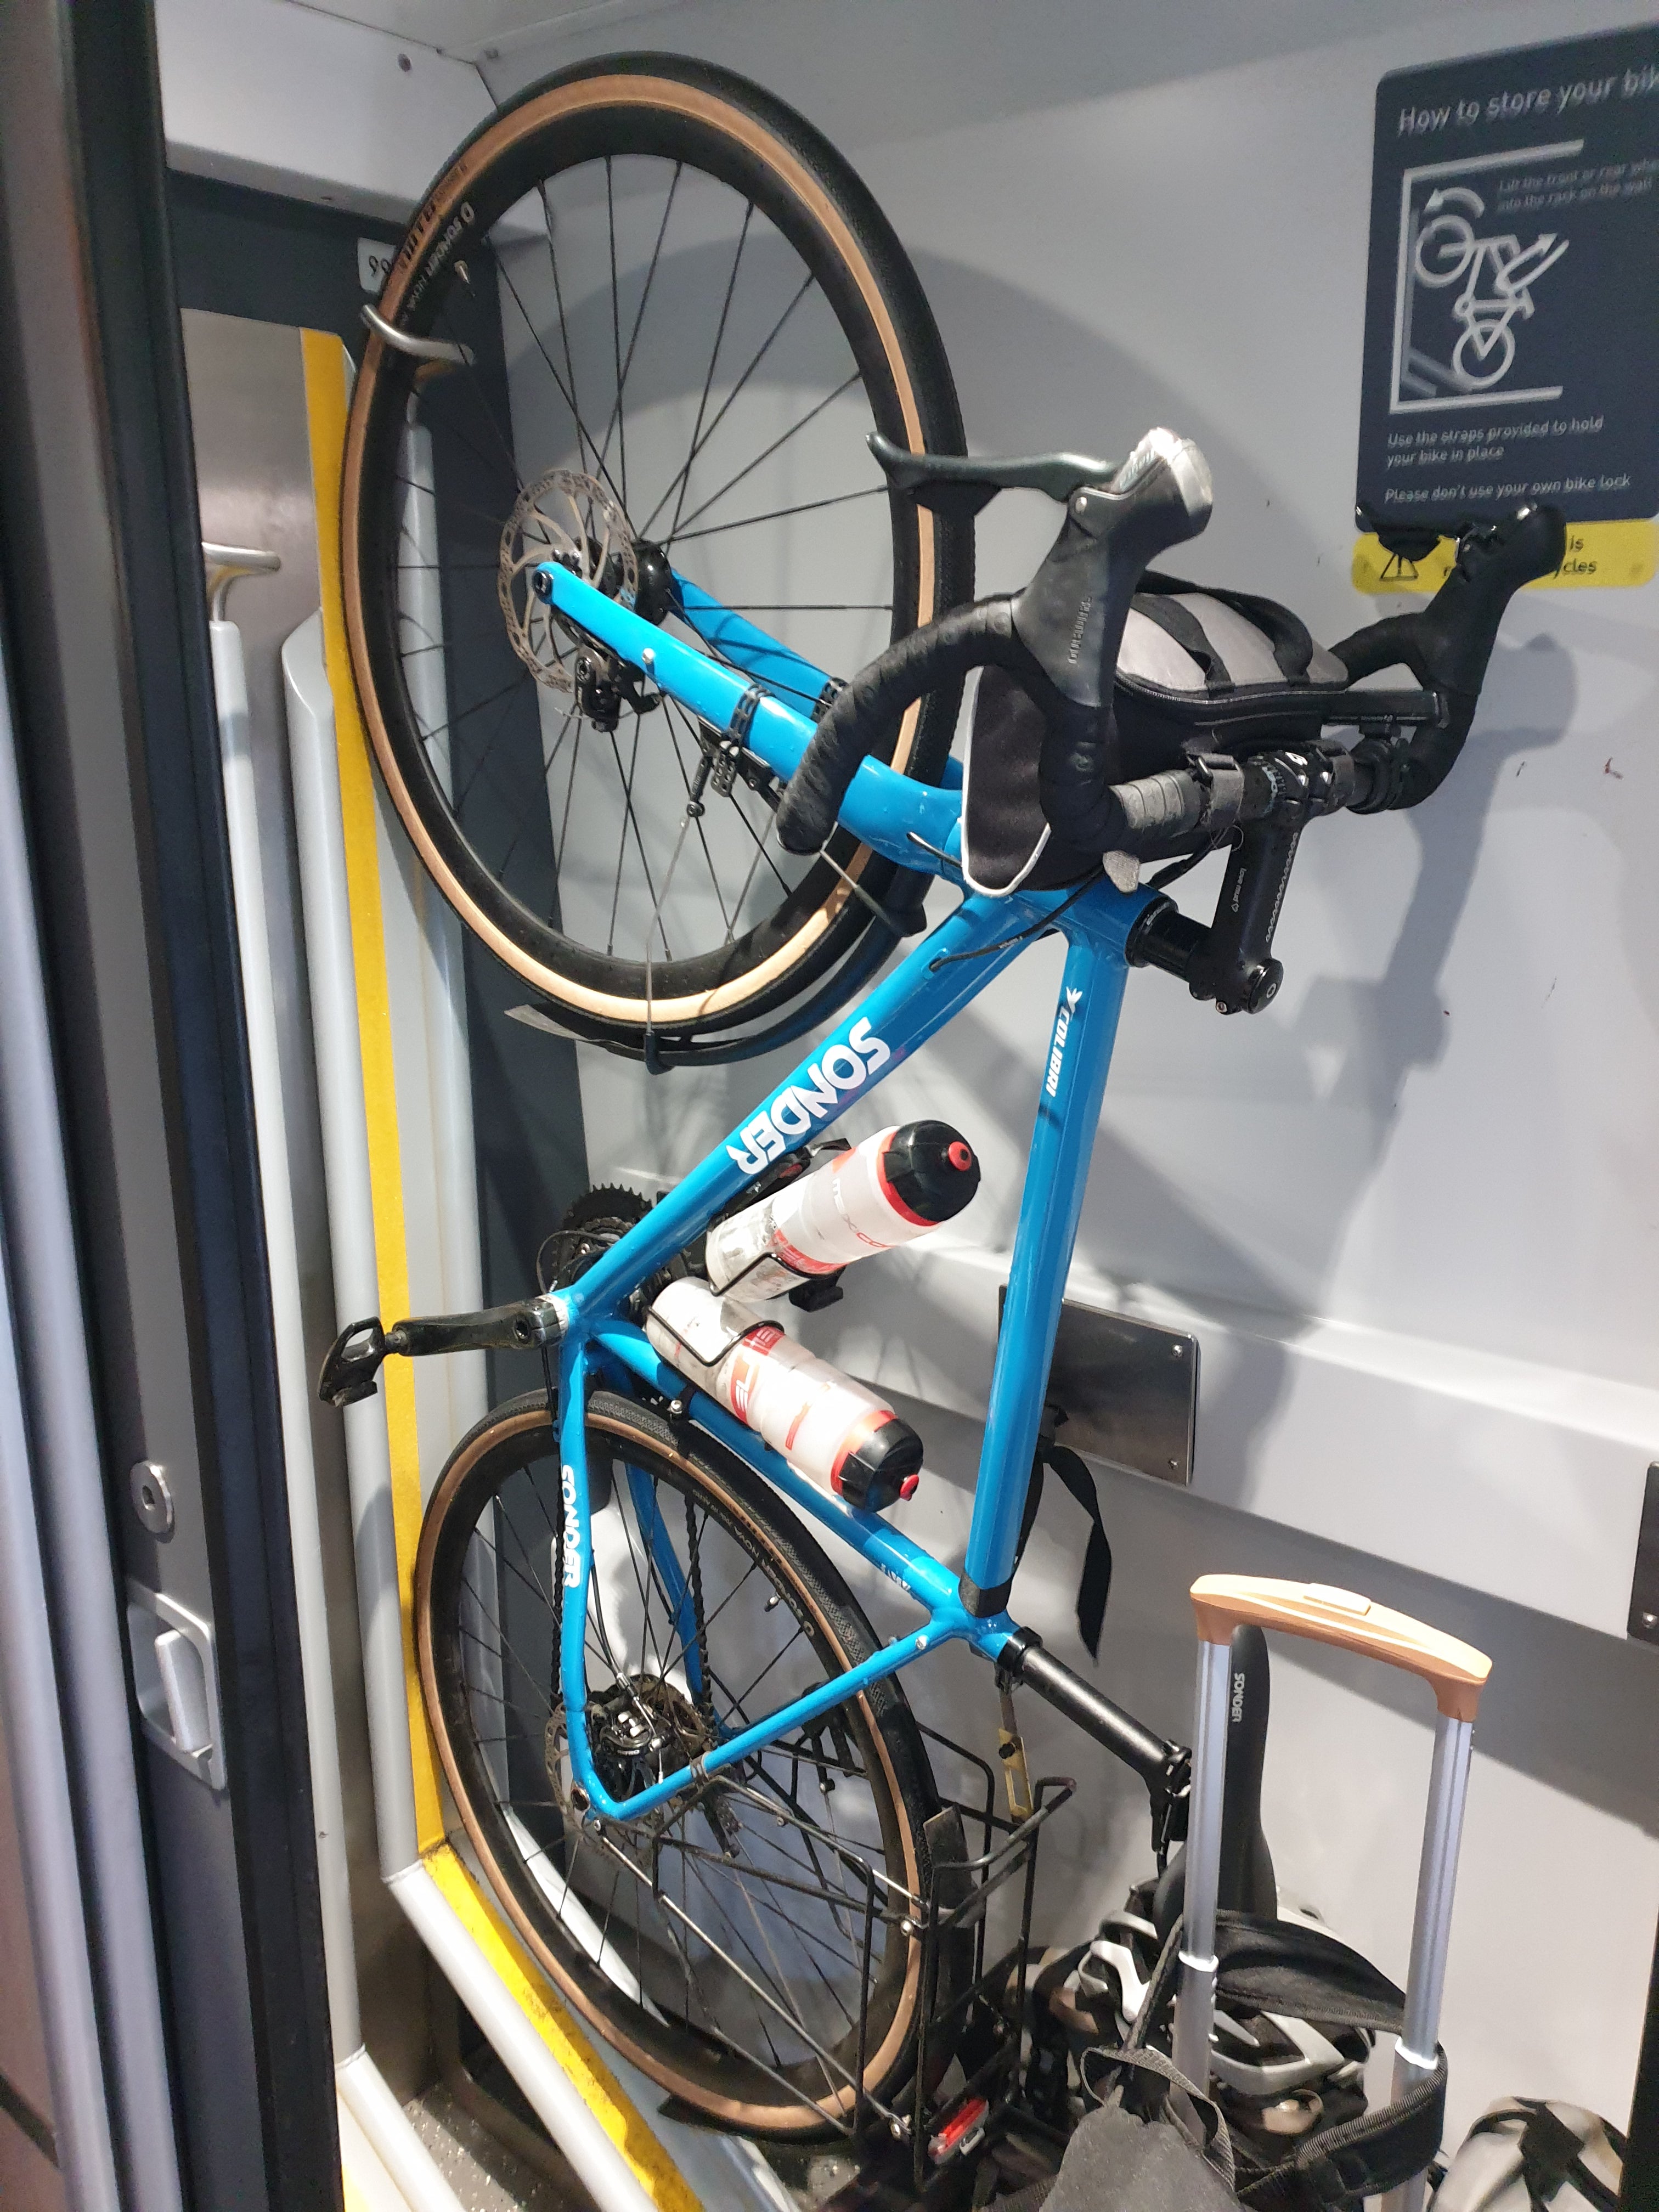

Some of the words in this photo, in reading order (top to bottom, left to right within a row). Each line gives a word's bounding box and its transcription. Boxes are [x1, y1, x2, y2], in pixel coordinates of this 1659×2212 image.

[1397, 105, 1451, 137] How
[1456, 99, 1480, 126] to
[1486, 88, 1551, 122] store
[1557, 77, 1618, 115] your
[1621, 64, 1659, 99] bik
[1386, 453, 1417, 471] your
[1418, 449, 1448, 466] bike
[1451, 448, 1464, 462] in
[1466, 445, 1505, 463] place
[1387, 432, 1414, 448] Use
[1415, 430, 1438, 447] the
[1441, 428, 1484, 444] straps
[1486, 419, 1550, 444] provided
[1553, 419, 1567, 436] to
[1569, 415, 1605, 434] hold
[1384, 487, 1429, 504] Please
[1431, 484, 1466, 502] don't
[1468, 485, 1494, 500] use
[1496, 482, 1530, 501] your
[1532, 480, 1562, 495] own
[1565, 476, 1596, 493] bike
[1599, 472, 1632, 492] lock
[1045, 1005, 1070, 1098] COLIBRI
[725, 1016, 891, 1175] SONDER
[562, 1464, 581, 1588] SONDER
[1231, 1672, 1245, 1723] SONDER
